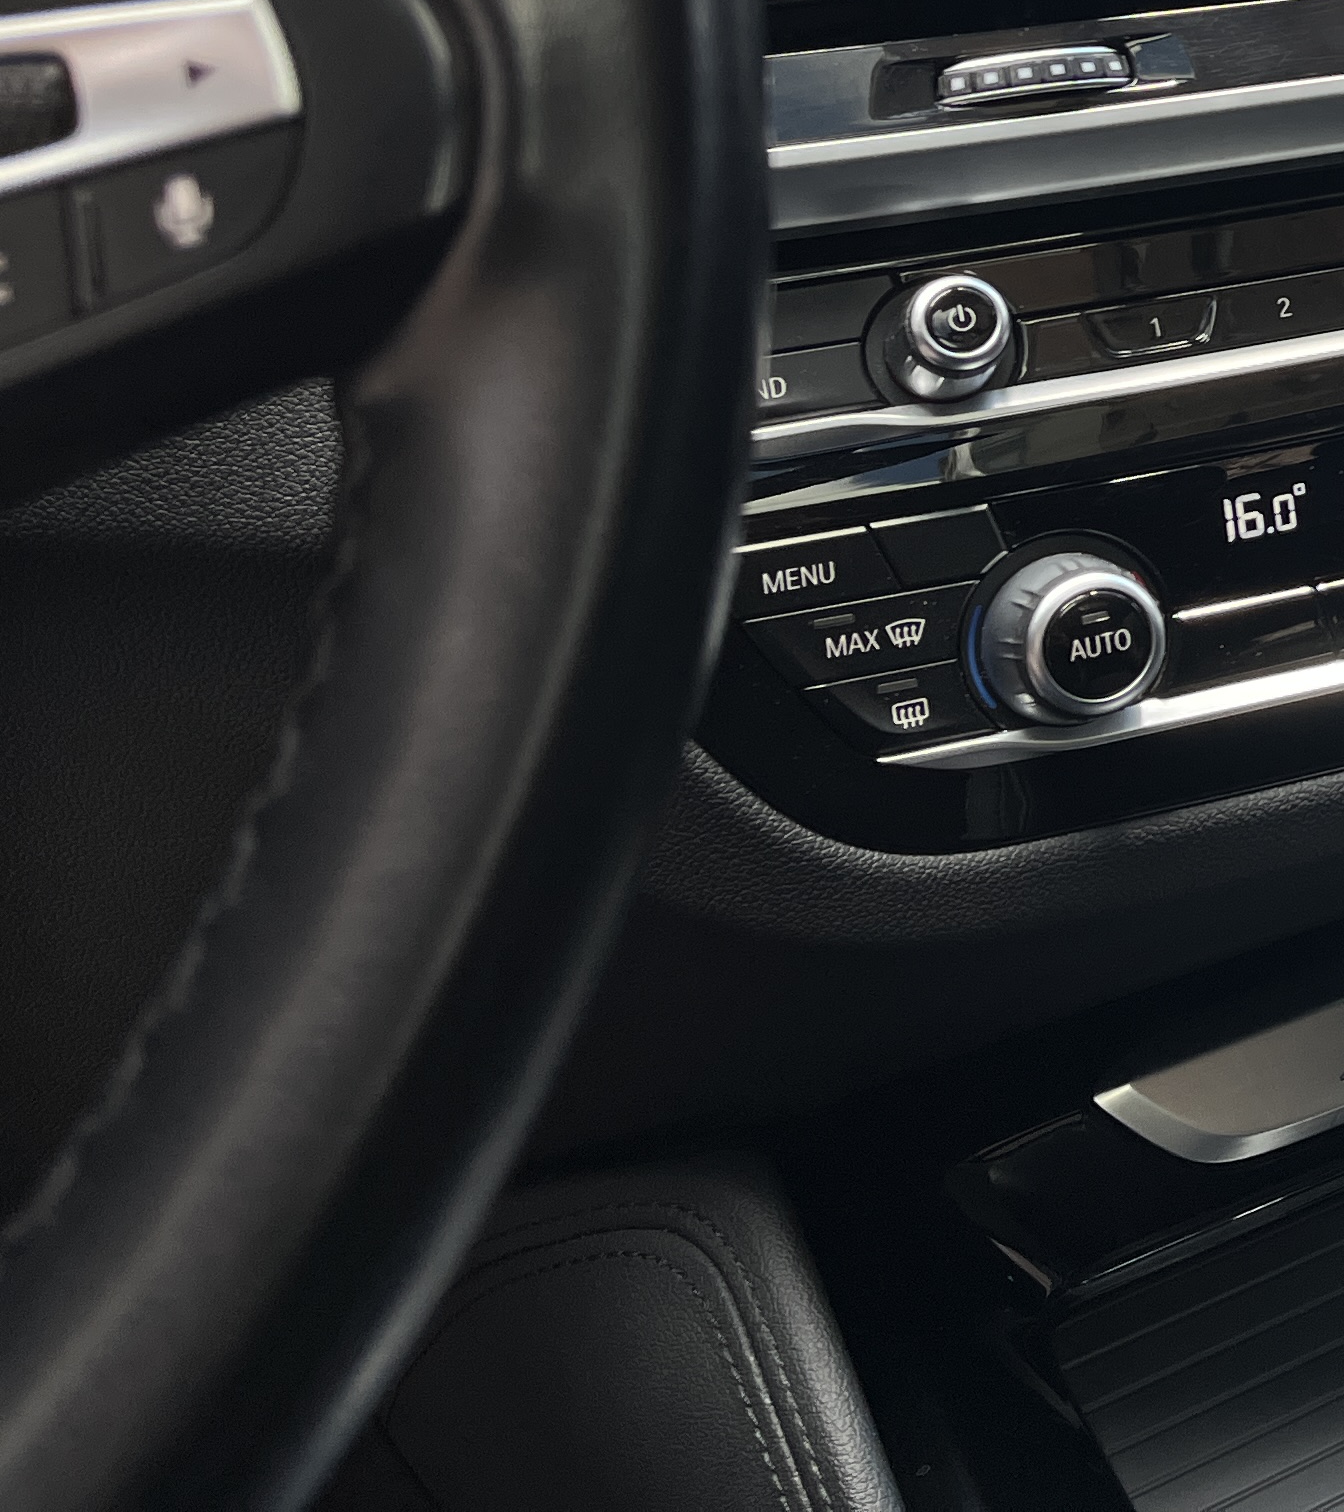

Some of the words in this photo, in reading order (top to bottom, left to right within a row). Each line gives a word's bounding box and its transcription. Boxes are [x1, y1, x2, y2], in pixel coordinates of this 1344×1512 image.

[1276, 297, 1294, 318] 2
[1150, 317, 1163, 338] 1
[762, 561, 836, 595] MENU
[825, 628, 881, 659] MAX
[1069, 628, 1132, 663] AUTO
